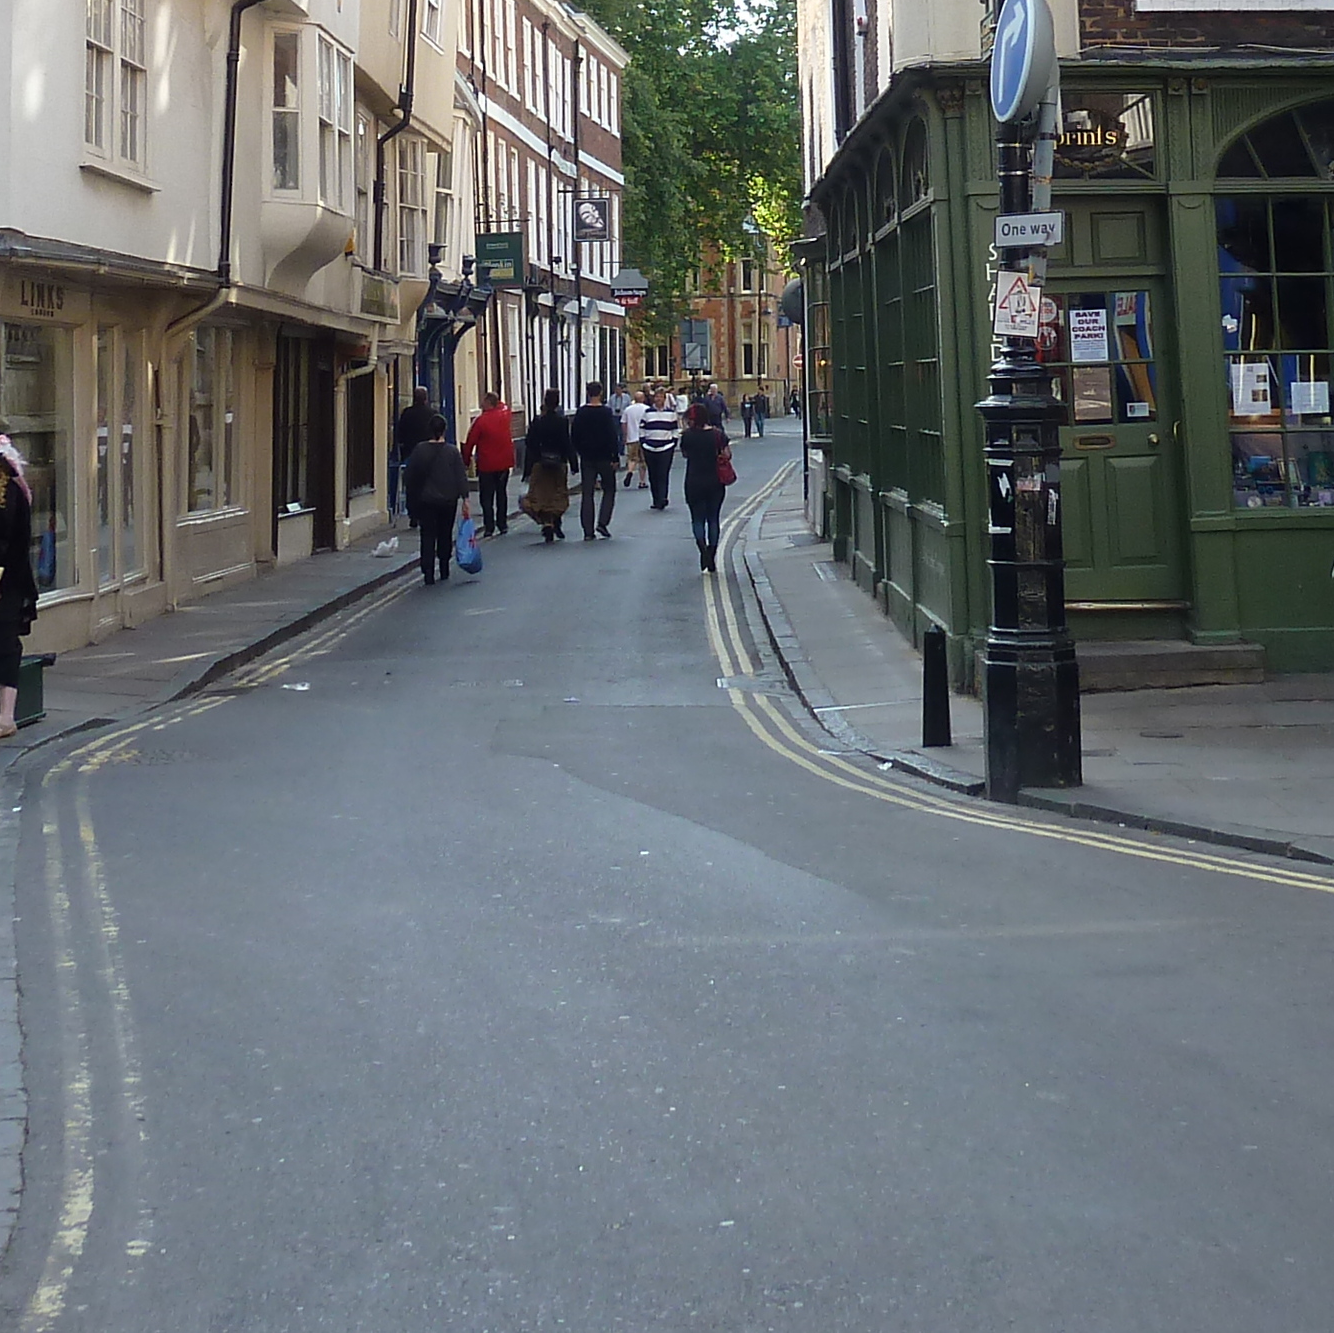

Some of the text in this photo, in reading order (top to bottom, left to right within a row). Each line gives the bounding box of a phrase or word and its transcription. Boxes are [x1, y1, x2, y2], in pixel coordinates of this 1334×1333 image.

[1001, 222, 1056, 239] One way
[20, 280, 64, 310] LINKS
[986, 243, 1004, 362] SHAD
